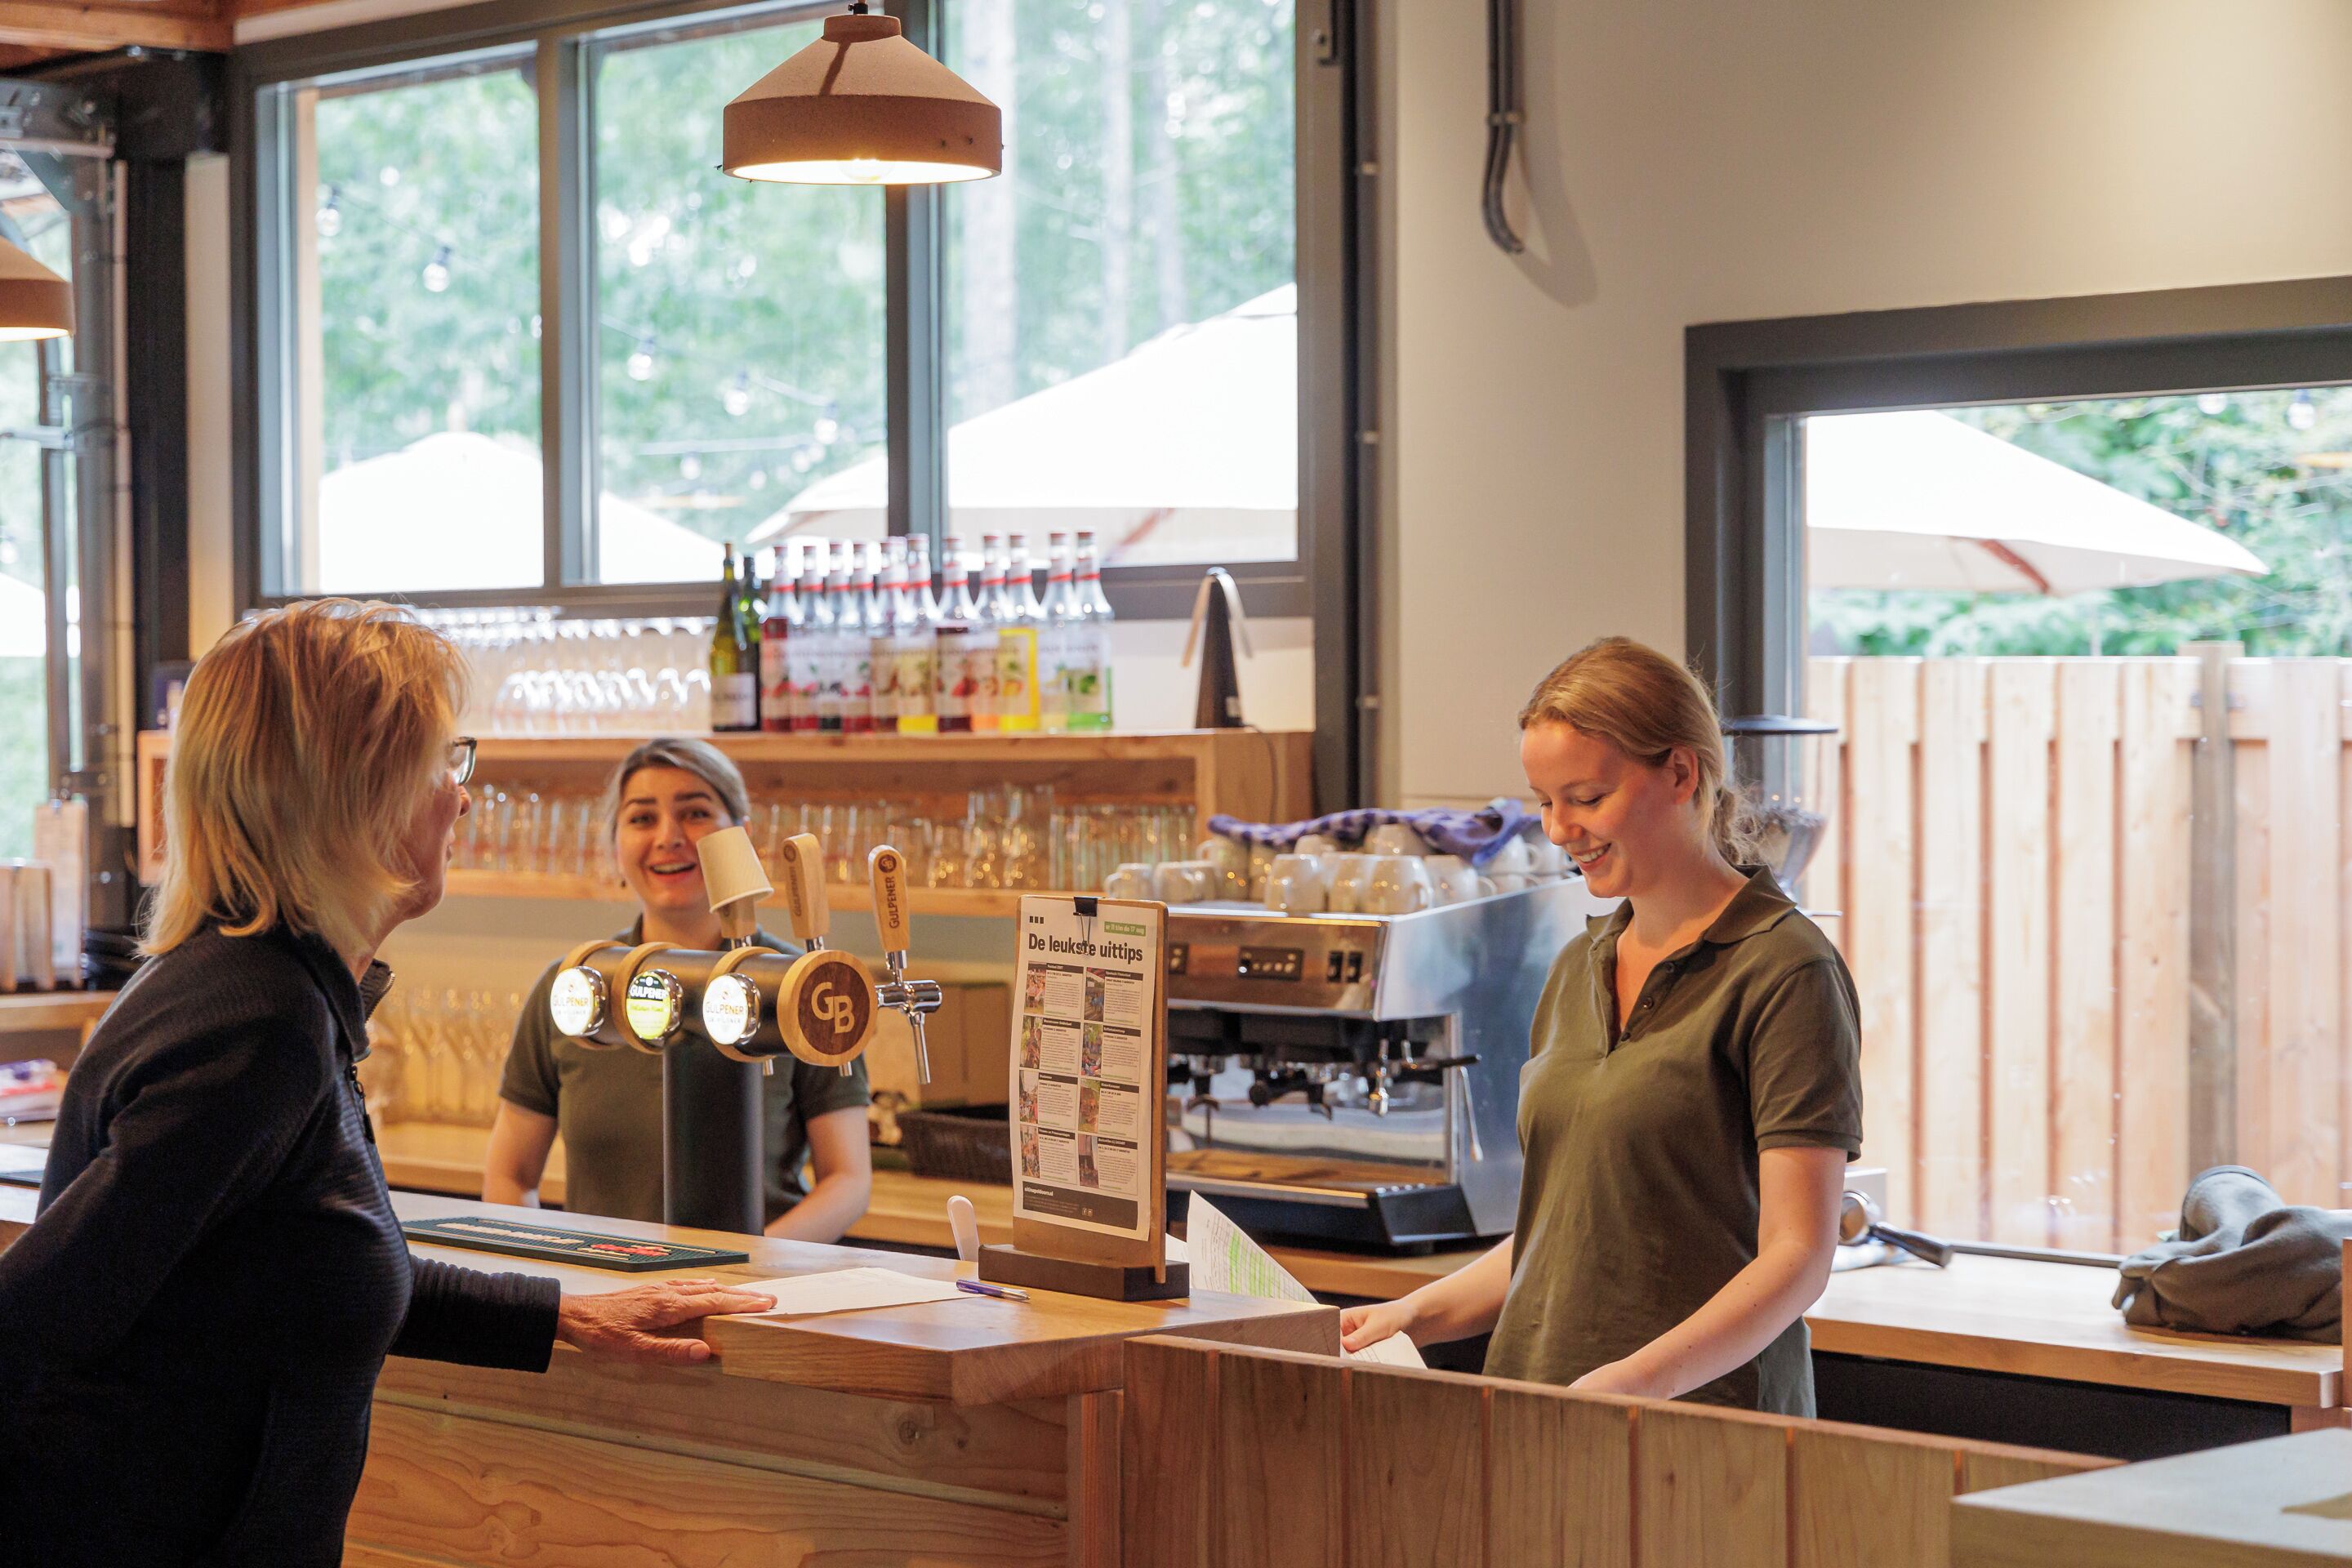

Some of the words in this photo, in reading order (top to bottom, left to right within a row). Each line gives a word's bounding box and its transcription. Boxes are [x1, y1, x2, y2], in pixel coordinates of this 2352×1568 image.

[885, 876, 900, 929] GULPENER
[1028, 933, 1045, 951] De
[1049, 935, 1096, 956] leukste
[1100, 941, 1143, 964] uittips
[553, 994, 589, 1007] GULPENER
[630, 984, 667, 1000] GULPENER
[705, 1001, 744, 1015] GULPENER
[811, 982, 855, 1034] GB
